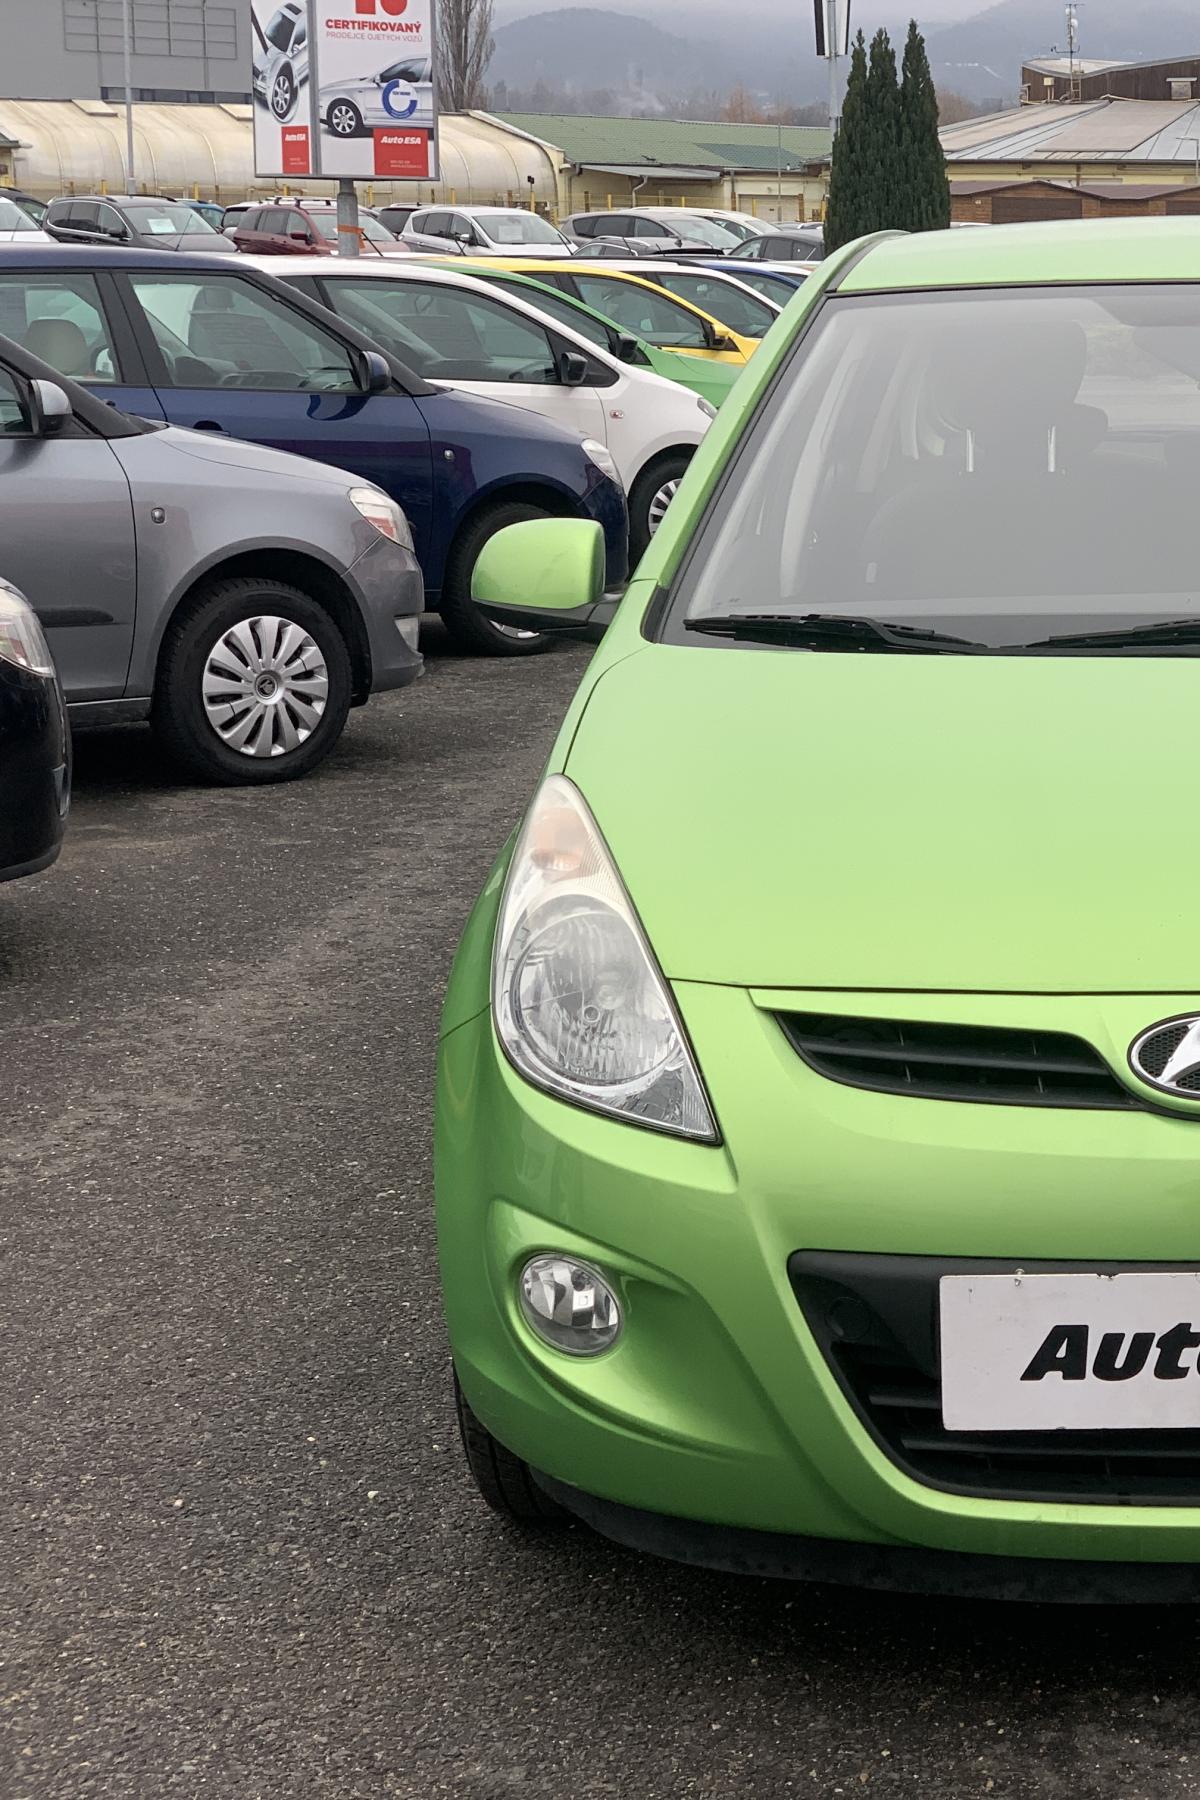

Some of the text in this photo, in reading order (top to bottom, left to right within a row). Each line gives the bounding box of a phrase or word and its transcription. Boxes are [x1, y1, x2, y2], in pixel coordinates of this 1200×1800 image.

[325, 19, 421, 33] CERTIFIKOVANÝ
[326, 31, 366, 40] PRODEJCE
[380, 136, 421, 144] Auto ESA
